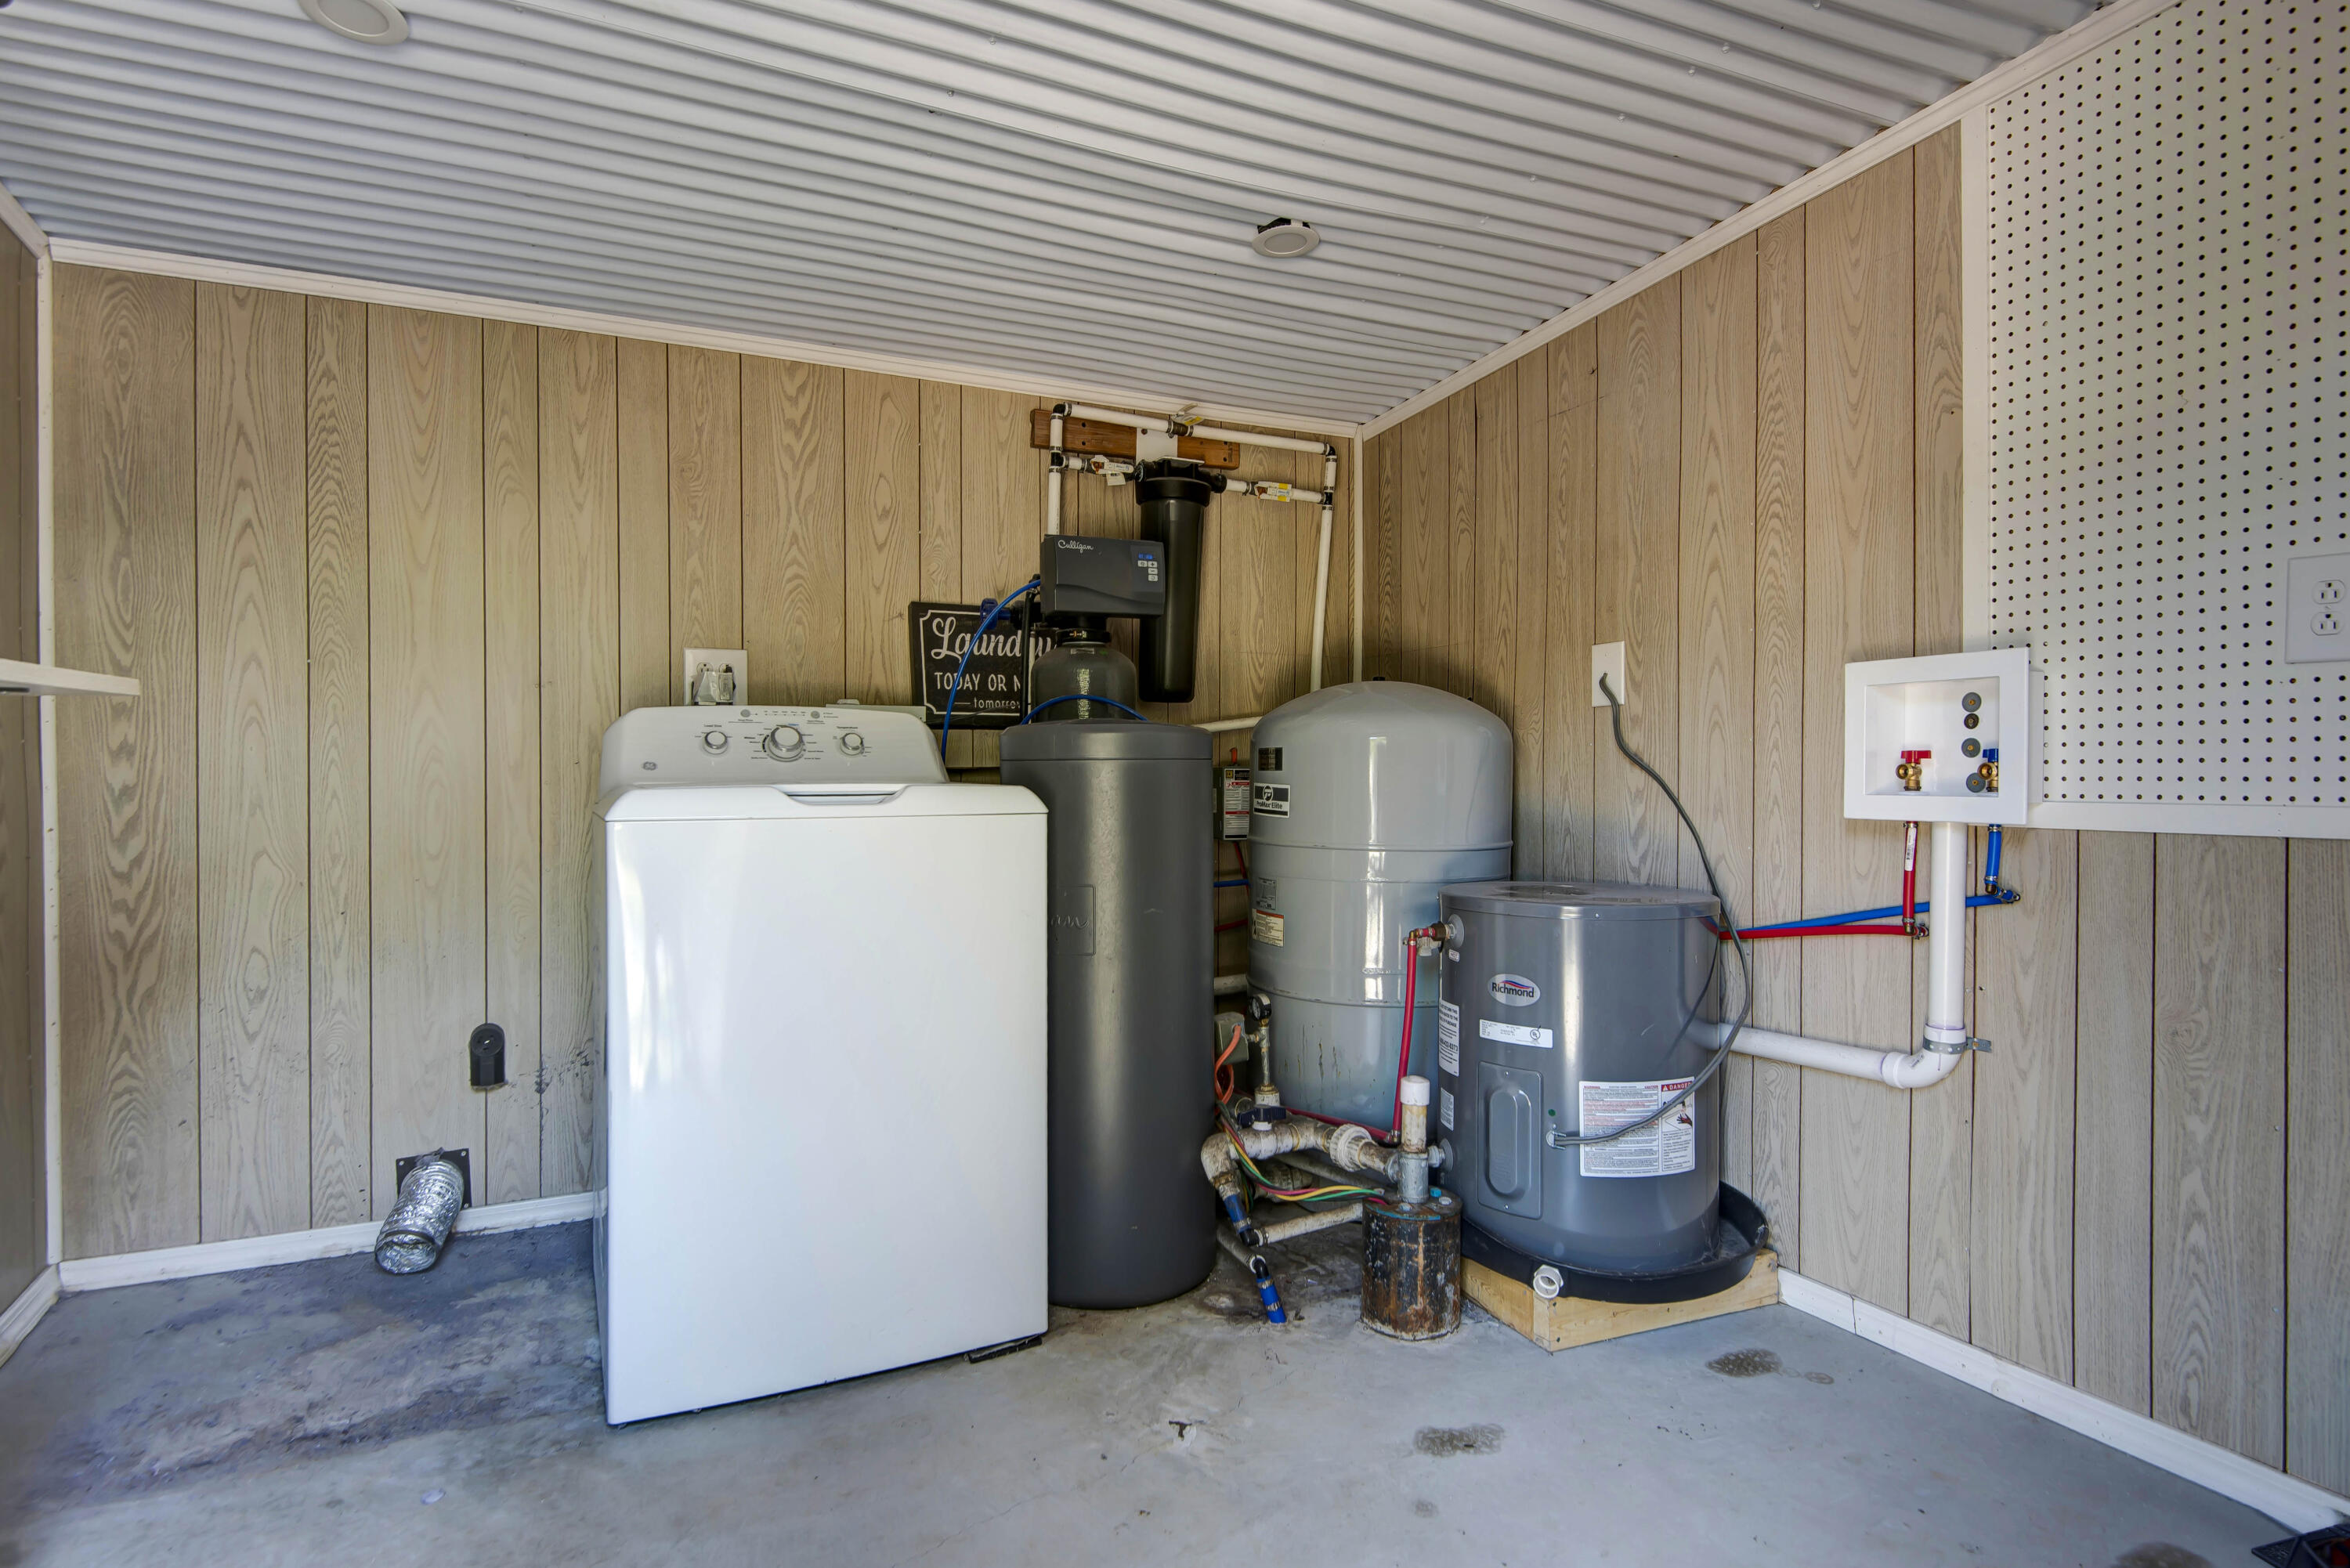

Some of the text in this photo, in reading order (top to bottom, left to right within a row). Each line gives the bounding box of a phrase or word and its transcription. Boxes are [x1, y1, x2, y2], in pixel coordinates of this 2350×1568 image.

[1058, 540, 1094, 554] Culligan
[931, 616, 1053, 663] Laundy
[935, 672, 980, 691] TODAY
[988, 674, 1007, 692] OR
[1271, 801, 1283, 811] Elite
[1492, 982, 1535, 998] Richmond
